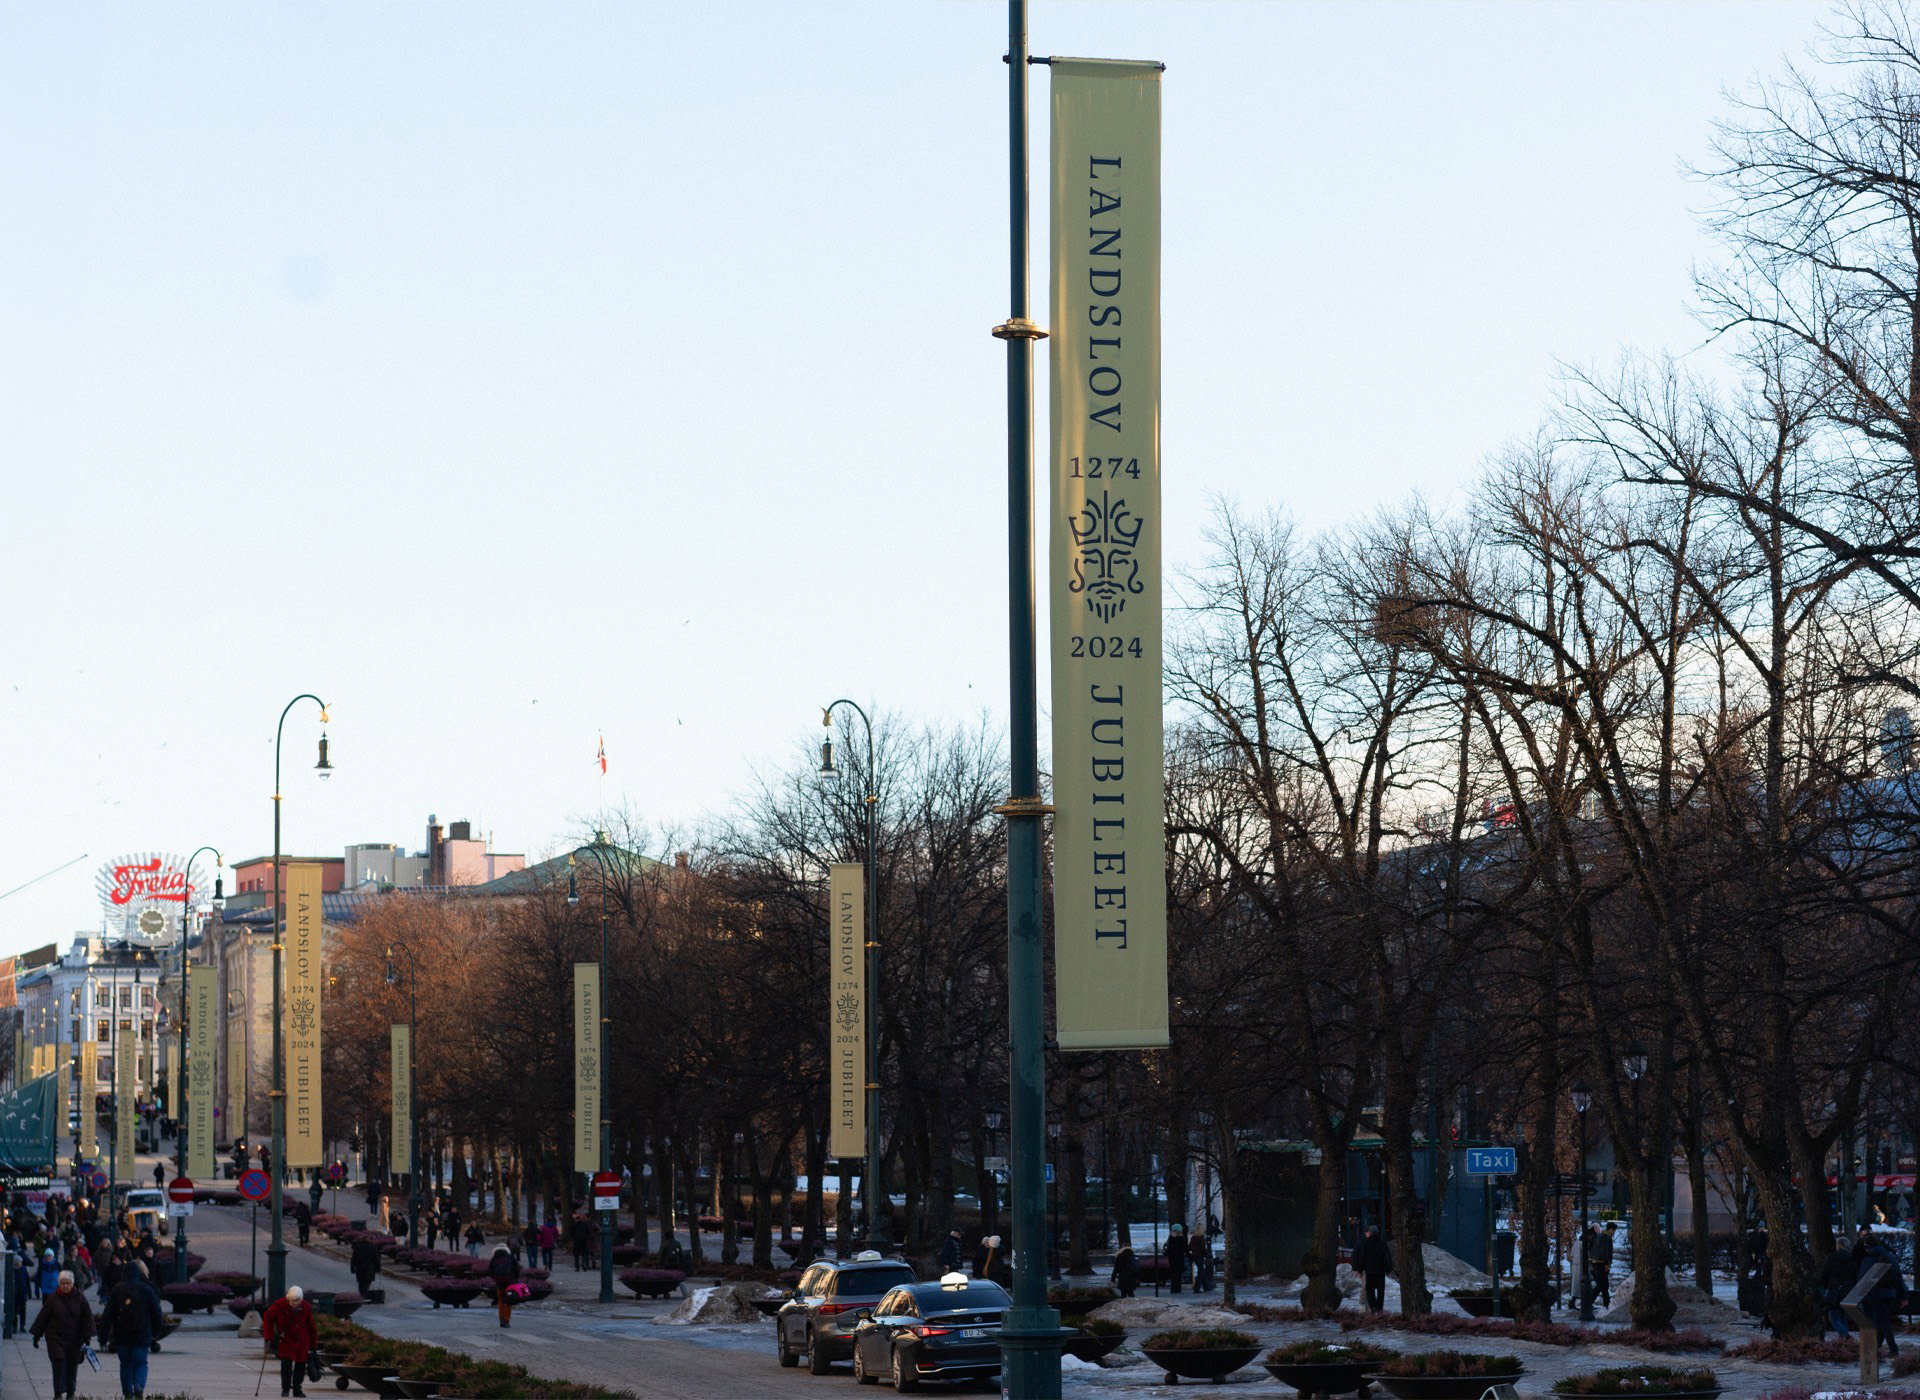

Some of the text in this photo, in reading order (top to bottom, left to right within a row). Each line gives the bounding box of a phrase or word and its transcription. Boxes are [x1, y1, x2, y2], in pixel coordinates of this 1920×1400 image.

[1088, 155, 1122, 433] LANDSLOV
[1070, 457, 1141, 480] 1274
[1071, 636, 1143, 659] 2024
[1091, 684, 1127, 950] JUBILEET
[110, 858, 196, 904] Freia
[298, 892, 310, 980] LANDSLOV
[841, 892, 853, 976] LANDSLOV
[291, 986, 315, 994] 1274
[582, 983, 591, 1043] LANDSLOV
[837, 981, 859, 990] 1274
[199, 985, 208, 1048] LANDSLOV
[291, 1040, 315, 1049] 2024
[836, 1035, 859, 1043] 2024
[298, 1055, 310, 1138] JUBILEET
[842, 1049, 854, 1130] JUBILEET
[196, 1102, 206, 1158] JUBILEET
[583, 1095, 593, 1153] JUBILEET
[16, 1177, 49, 1187] SHOPPING
[1472, 1152, 1509, 1167] Taxi
